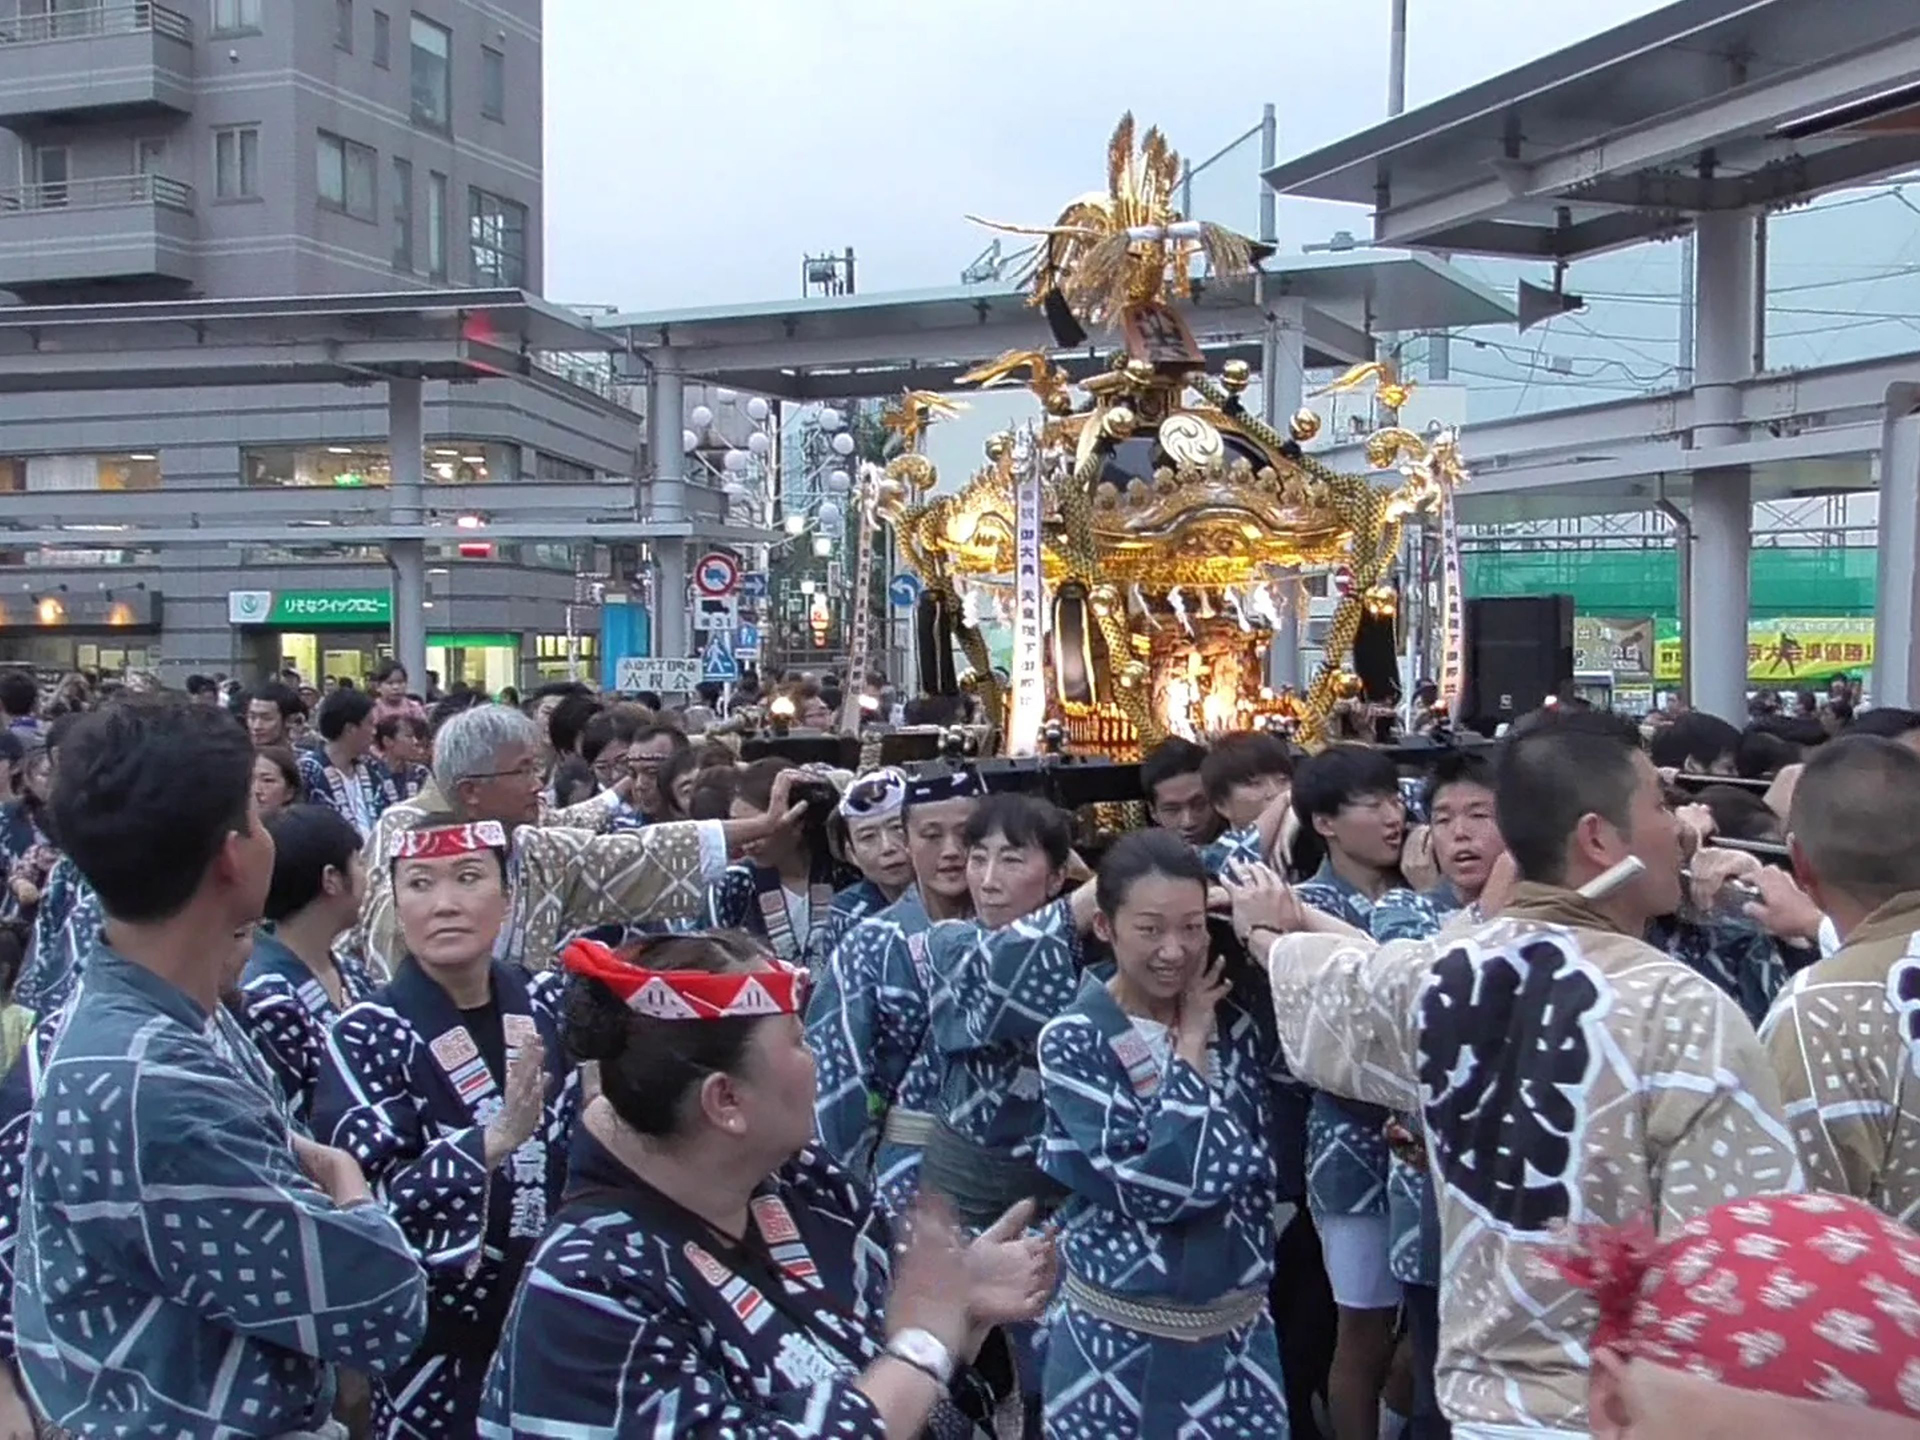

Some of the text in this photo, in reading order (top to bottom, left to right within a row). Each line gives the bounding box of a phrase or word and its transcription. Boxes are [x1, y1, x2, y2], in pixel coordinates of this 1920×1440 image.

[285, 599, 388, 614] りそなクイックロビー
